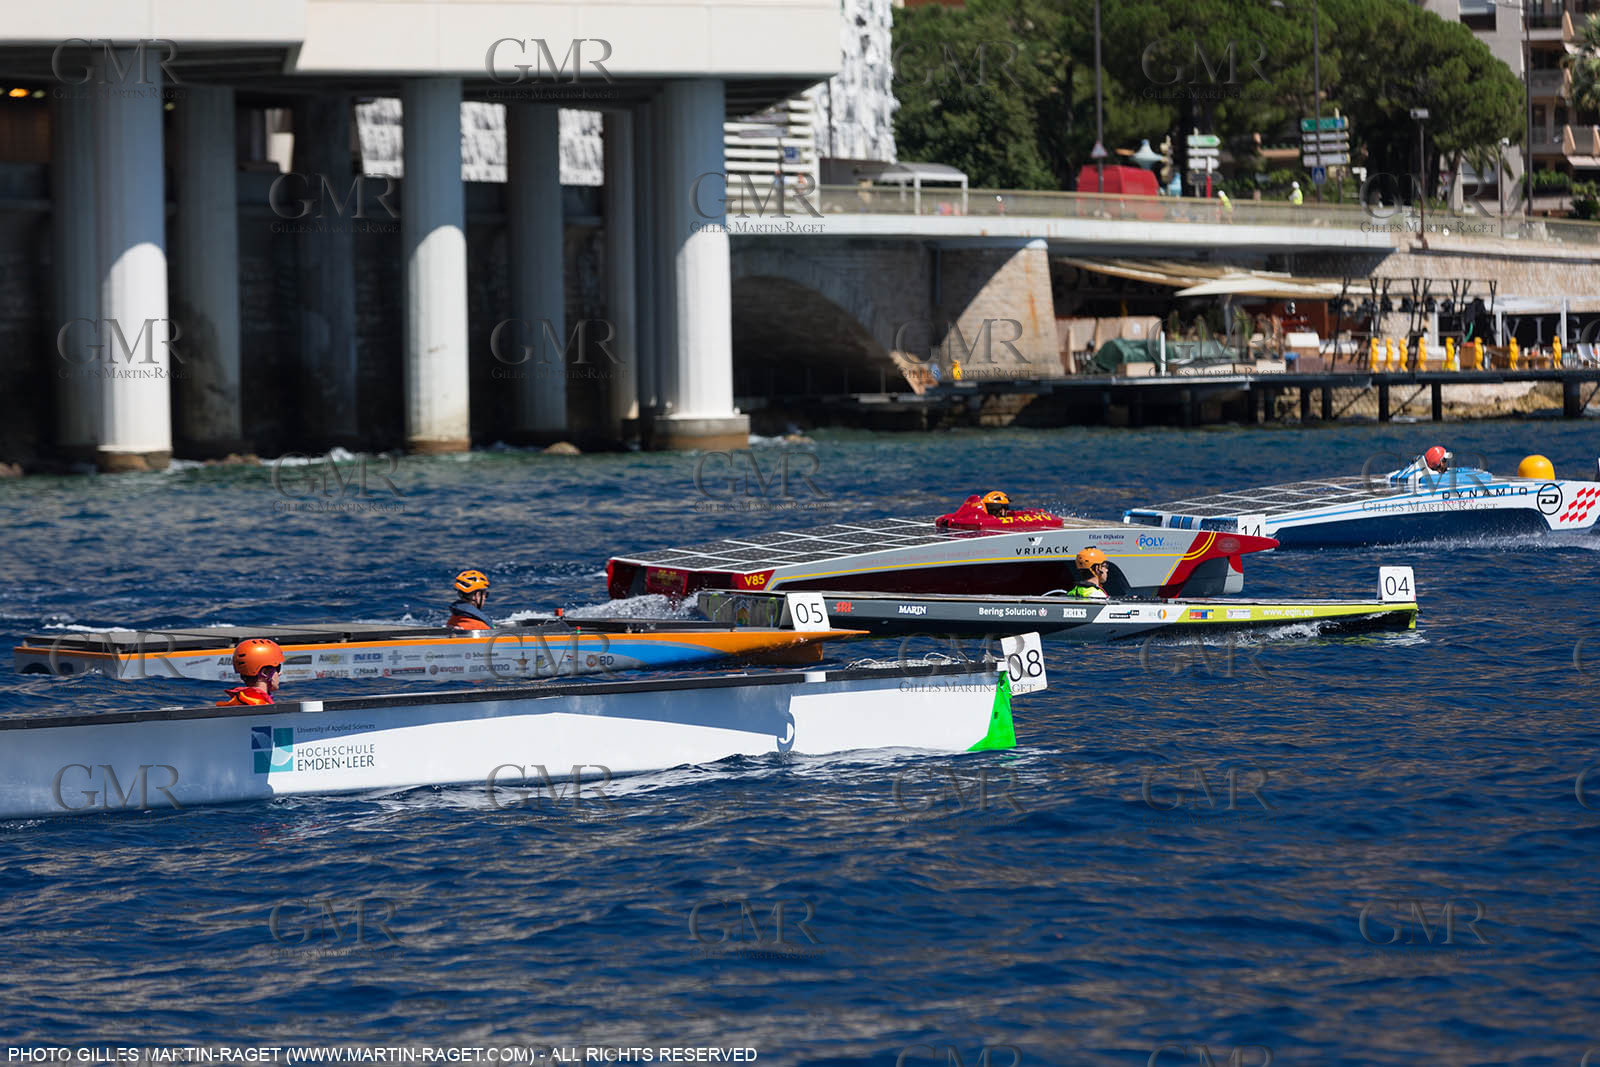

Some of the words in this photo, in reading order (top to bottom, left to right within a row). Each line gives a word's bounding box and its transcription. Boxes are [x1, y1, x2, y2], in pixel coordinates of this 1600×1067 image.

[1442, 487, 1528, 500] DYNAMIQ
[1139, 537, 1165, 547] POLY
[1016, 546, 1069, 555] VRIPACK
[744, 574, 765, 587] V85
[1385, 576, 1410, 596] 04
[795, 602, 824, 624] 05
[898, 605, 928, 616] MARIN
[979, 607, 1004, 617] Bering
[1005, 607, 1037, 617] Solution
[1063, 608, 1087, 618] ERIKS
[1007, 649, 1042, 682] 08
[297, 726, 324, 734] University
[332, 724, 351, 732] Applied
[353, 723, 375, 731] Sciences
[297, 744, 375, 758] HOCHSCHULE
